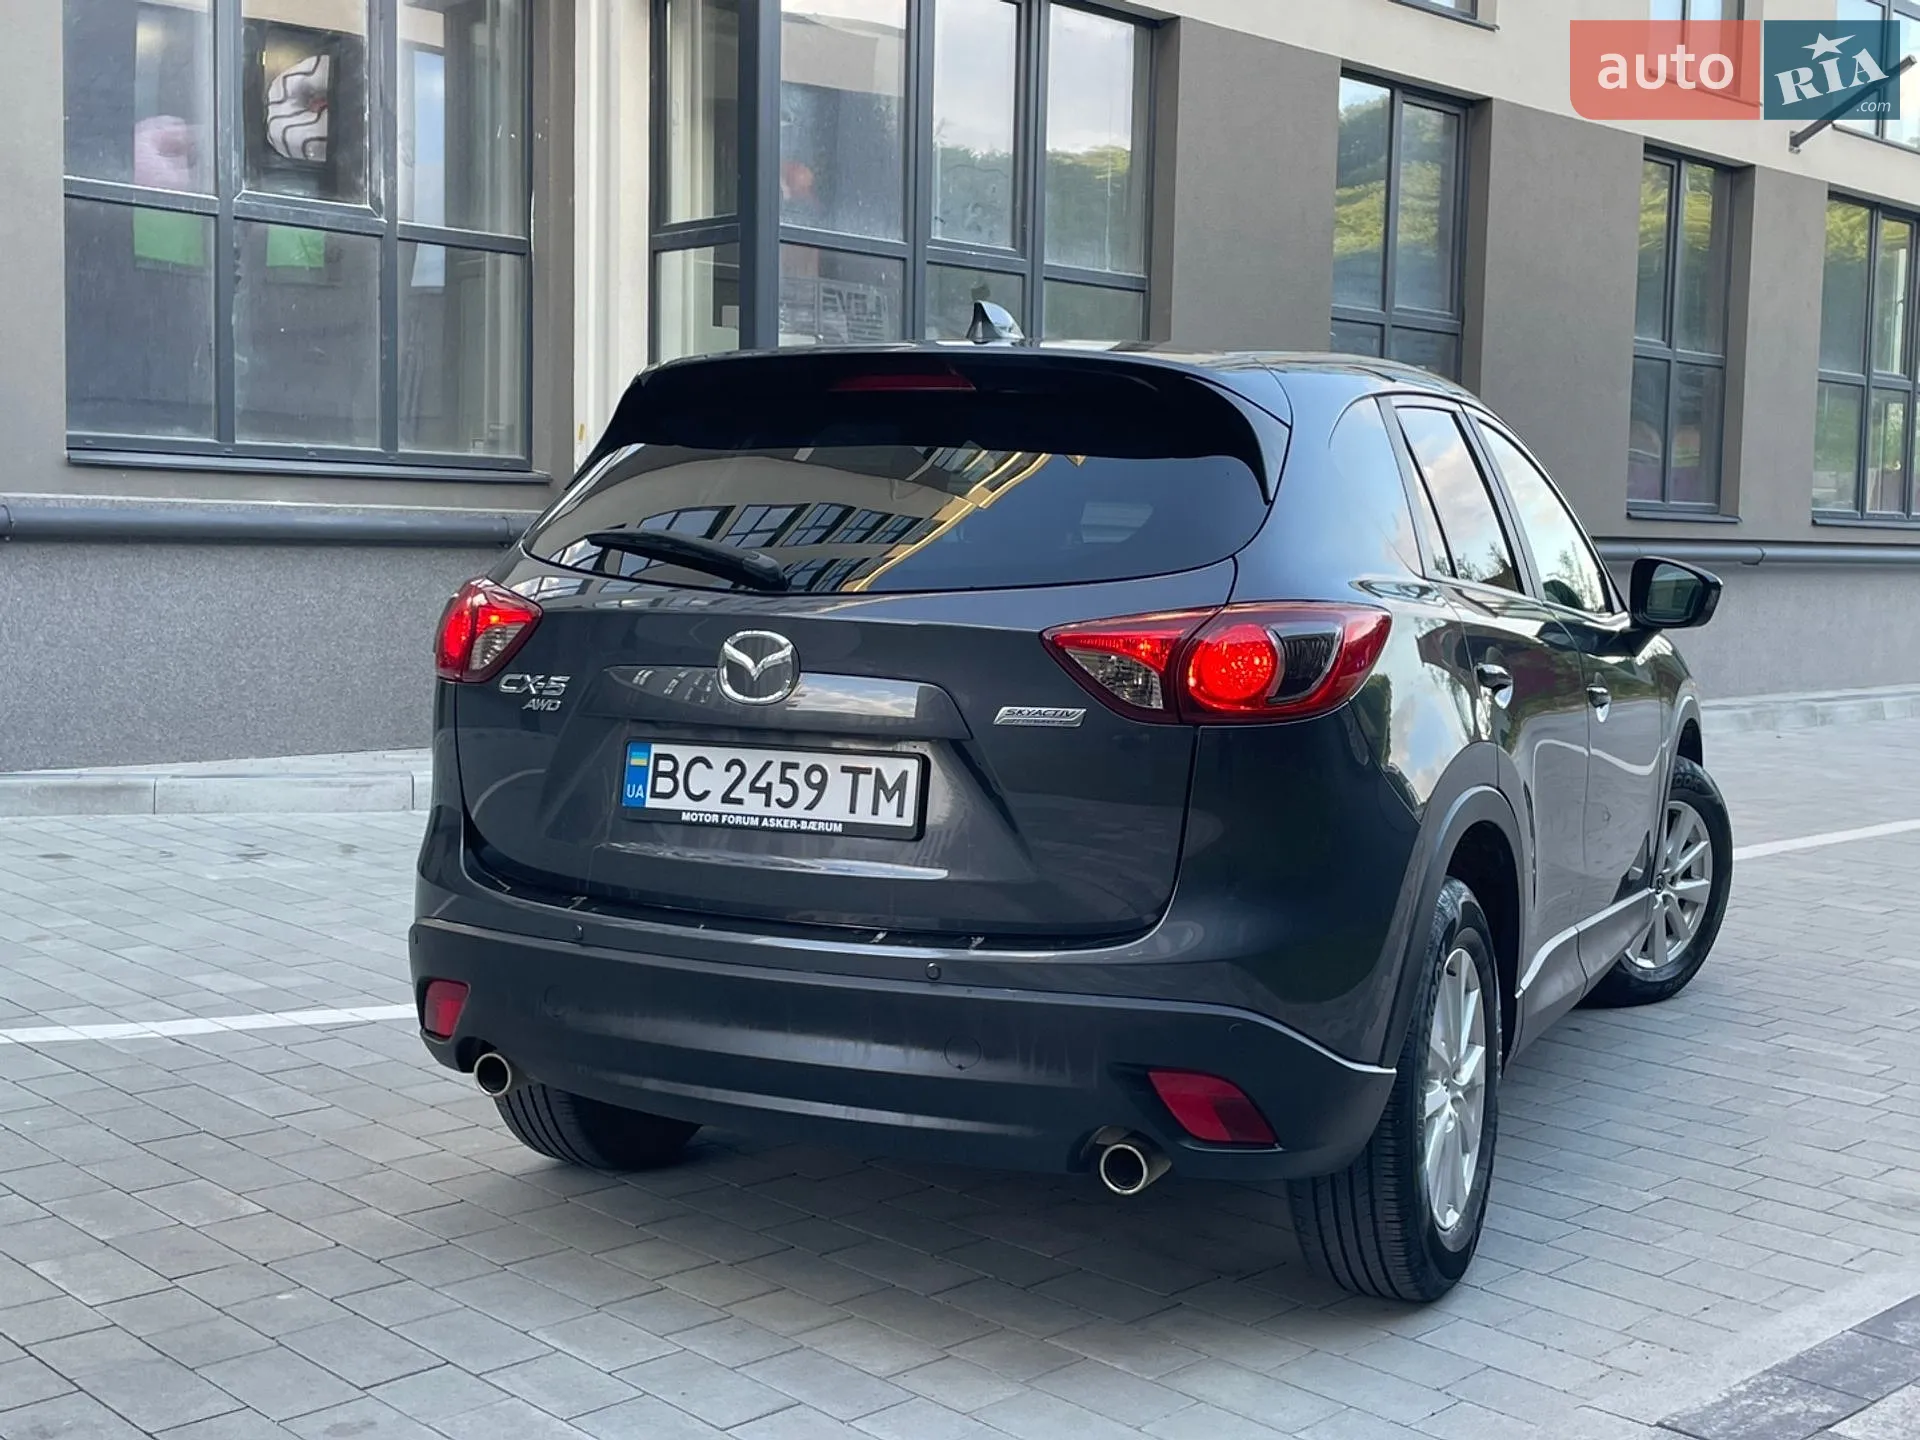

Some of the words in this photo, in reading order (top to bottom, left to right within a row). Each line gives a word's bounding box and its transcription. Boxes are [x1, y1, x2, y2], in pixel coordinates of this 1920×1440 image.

[499, 673, 571, 696] CX-5
[521, 698, 561, 711] AWD
[1004, 708, 1080, 717] SKYACTIV
[626, 784, 645, 799] UA
[649, 752, 713, 802] BC
[720, 758, 829, 811] 2459
[840, 765, 909, 818] TM
[681, 811, 719, 824] MOTOR
[721, 814, 759, 826] FORUM
[761, 817, 843, 833] ASKER-BÆRUM
